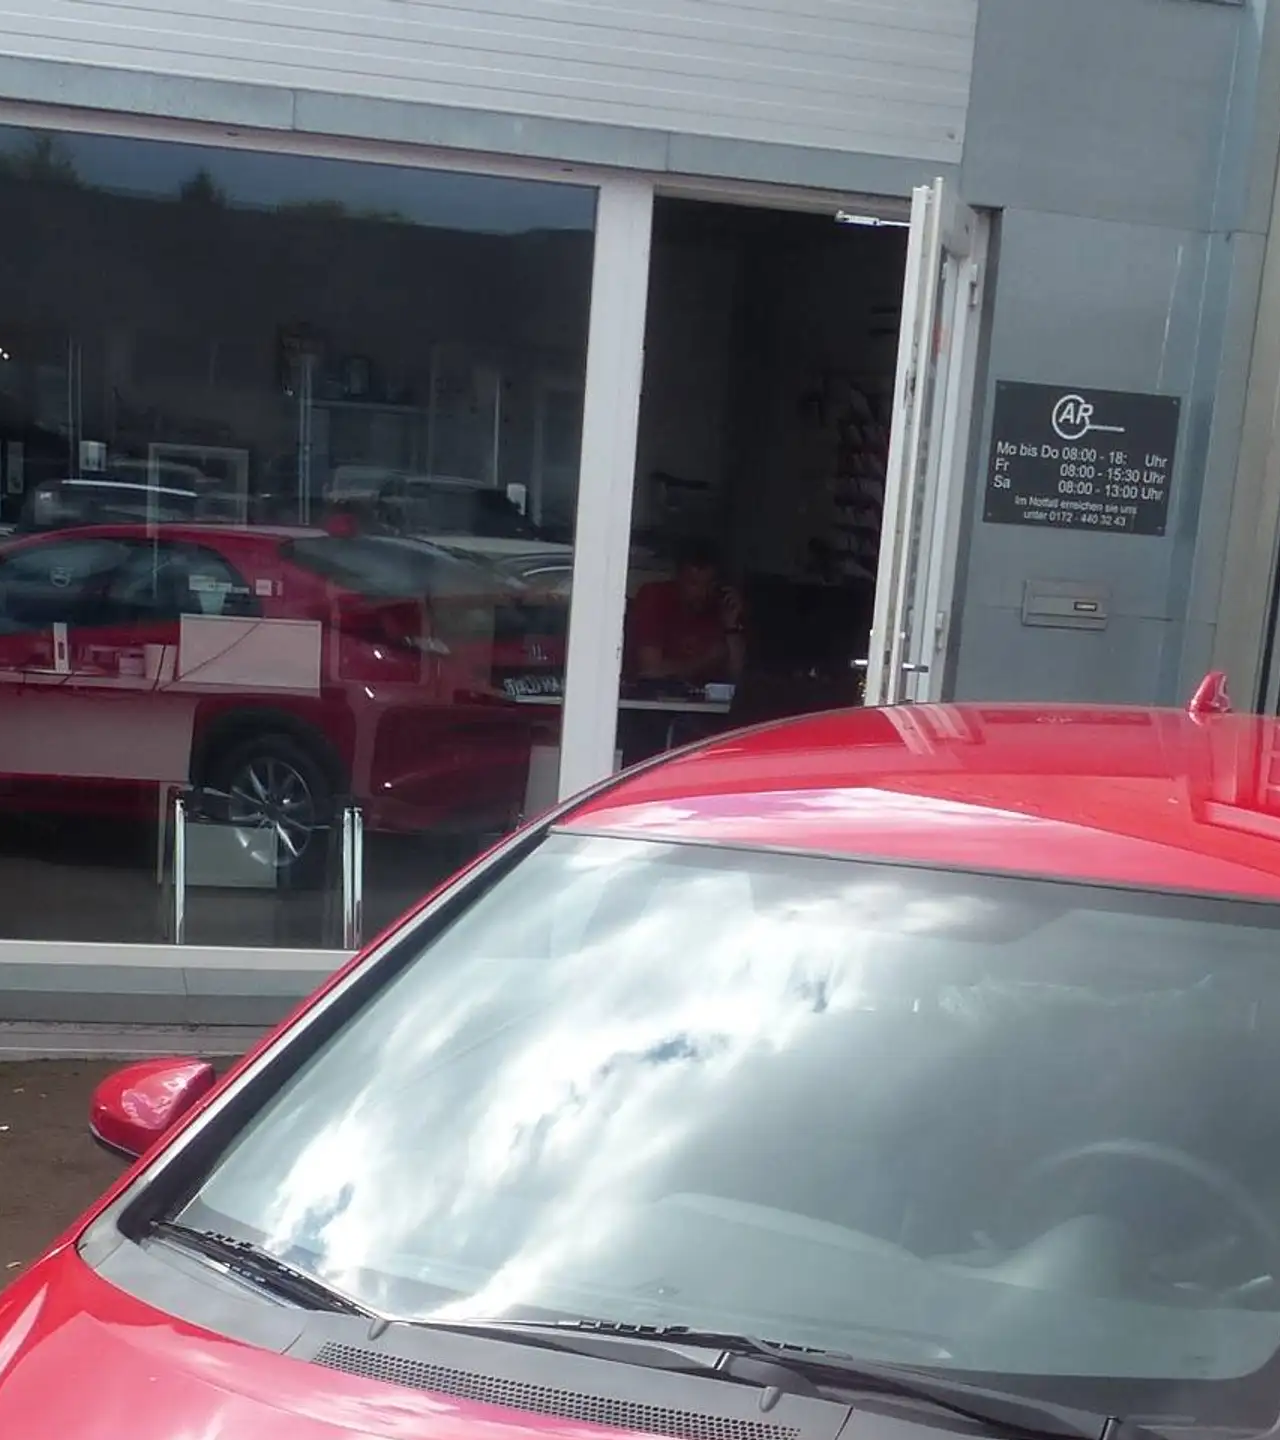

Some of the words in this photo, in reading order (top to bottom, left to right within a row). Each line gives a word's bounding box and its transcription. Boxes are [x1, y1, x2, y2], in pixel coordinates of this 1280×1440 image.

[1020, 443, 1038, 458] bis
[1041, 444, 1060, 459] Do
[1061, 446, 1098, 462] 08:00
[1144, 453, 1168, 468] Uhr
[995, 457, 1010, 471] Fr
[1060, 463, 1095, 478] 08:00
[1107, 467, 1140, 483] 15:30
[1142, 470, 1166, 485] Uhr
[993, 474, 1012, 489] Sa
[1058, 480, 1093, 495] 08:00
[1105, 483, 1138, 499] 13:00
[1141, 487, 1164, 501] Uhr
